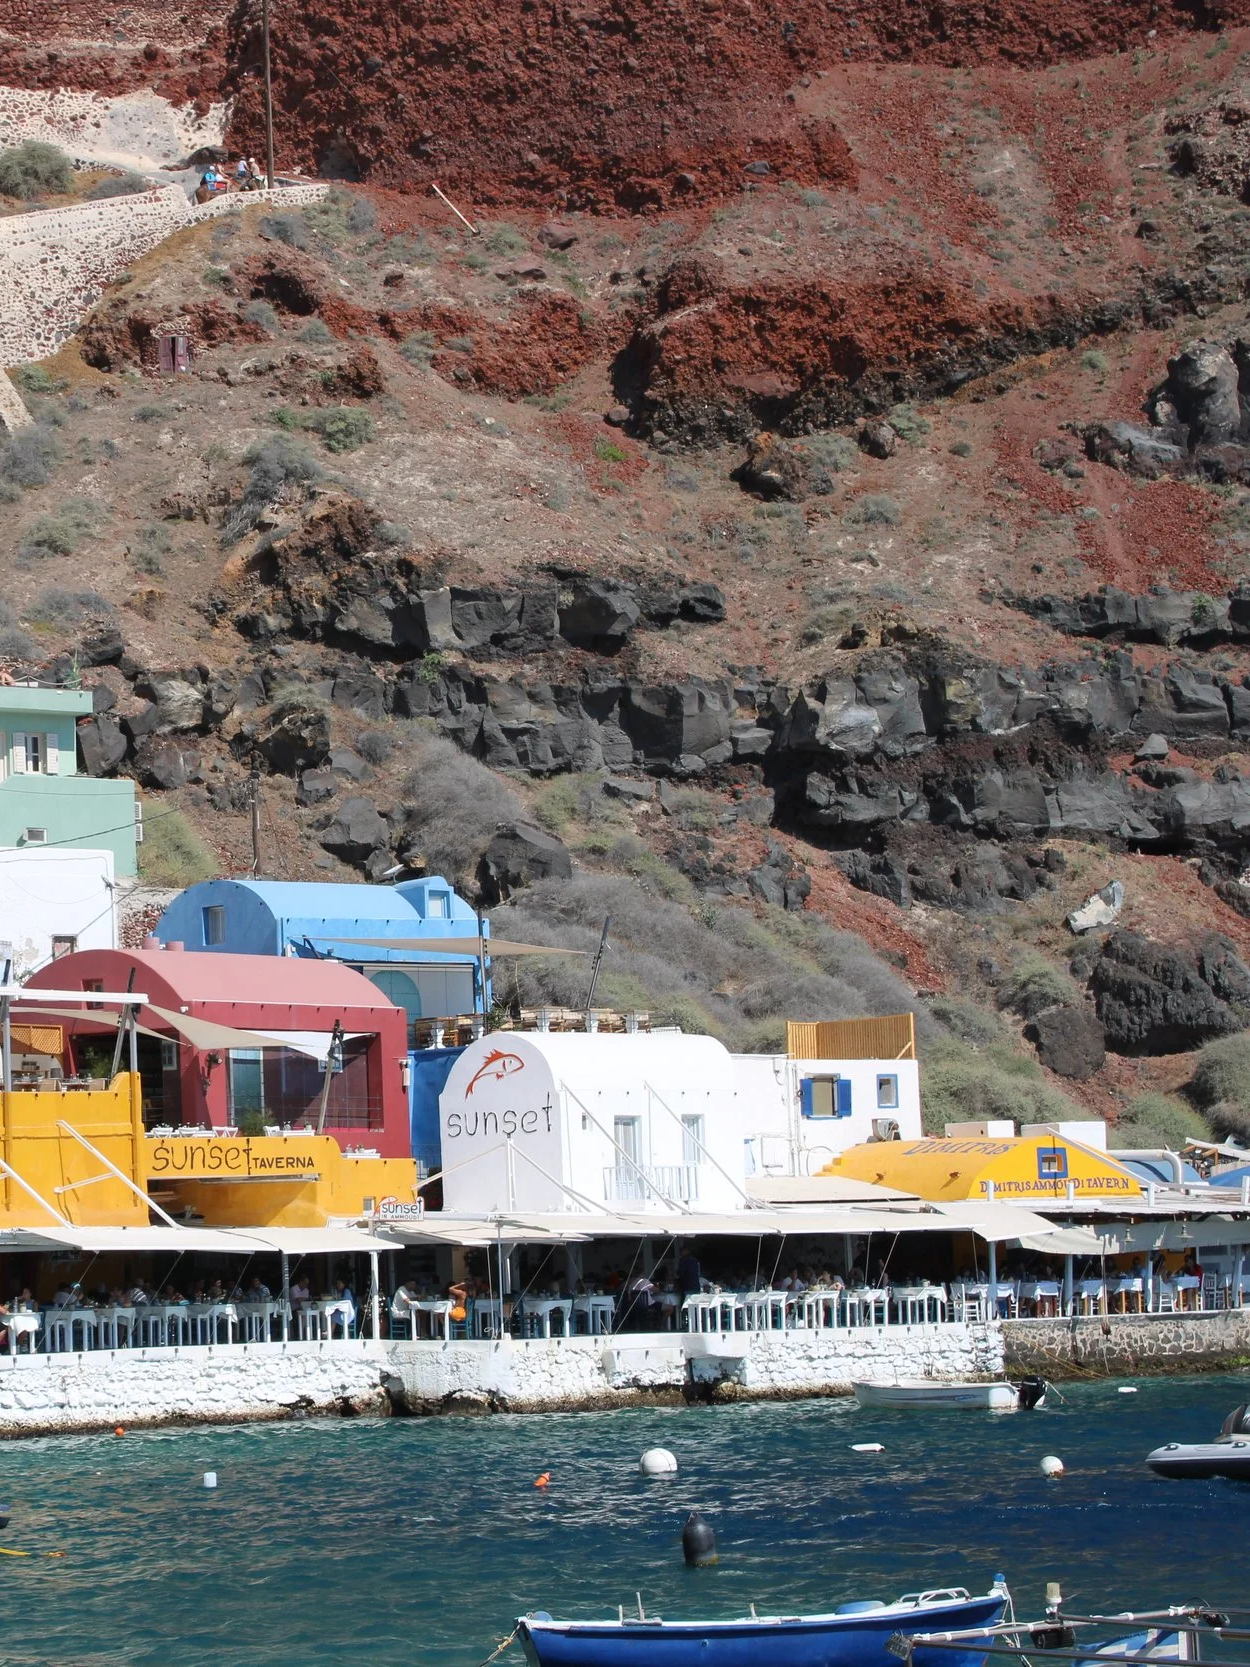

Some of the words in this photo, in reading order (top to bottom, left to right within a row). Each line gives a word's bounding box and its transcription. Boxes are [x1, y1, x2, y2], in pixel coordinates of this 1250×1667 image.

[902, 1140, 1018, 1156] DIMITRIS
[252, 1156, 315, 1169] TAVERNA
[979, 1179, 1031, 1193] DMITRIS
[1086, 1176, 1130, 1190] TAVERN
